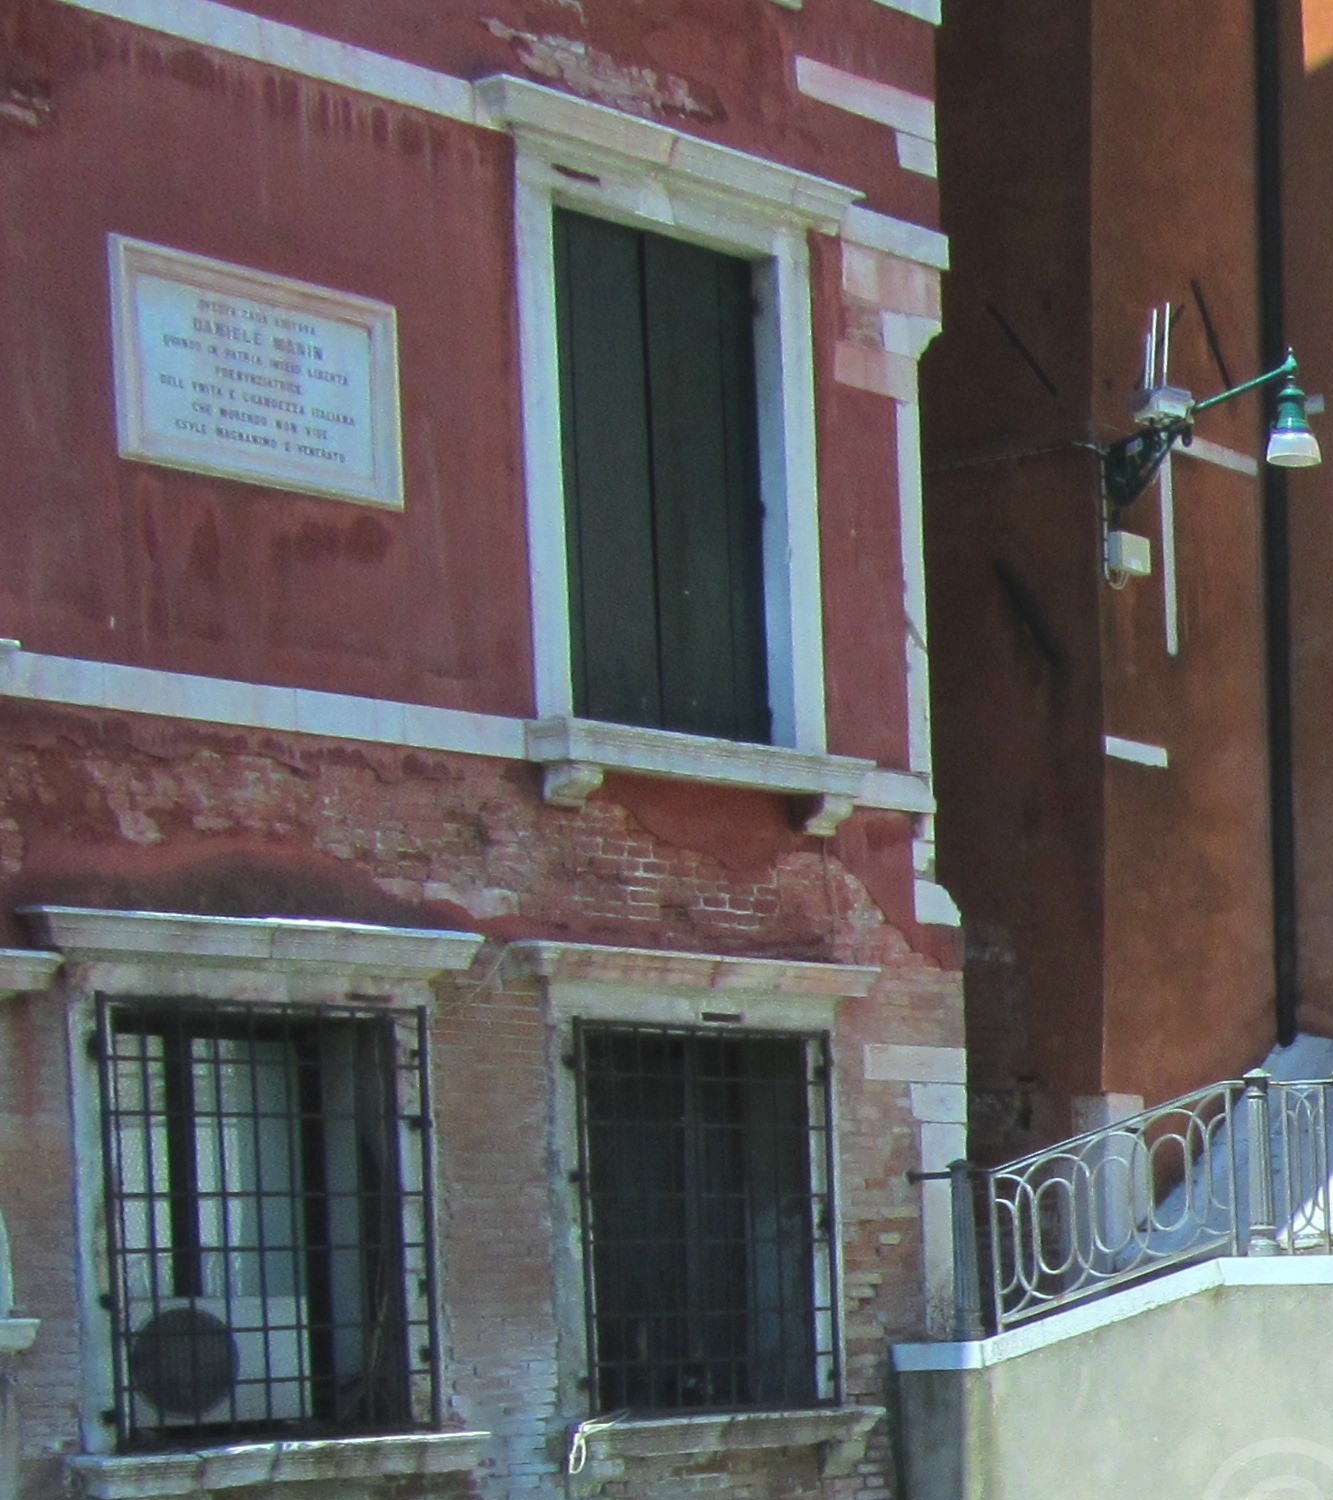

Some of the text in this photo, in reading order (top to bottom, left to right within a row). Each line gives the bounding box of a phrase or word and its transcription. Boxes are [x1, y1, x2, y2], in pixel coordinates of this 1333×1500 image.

[193, 318, 322, 360] DANIELE MANIN
[225, 348, 261, 363] PATRIA
[192, 401, 328, 440] CHE MORENDO NON VIDE
[244, 393, 304, 415] GRANDEZZA
[312, 407, 354, 426] ITALIANA
[216, 427, 276, 448] MAGNANIMO
[298, 445, 345, 463] VENERATO
